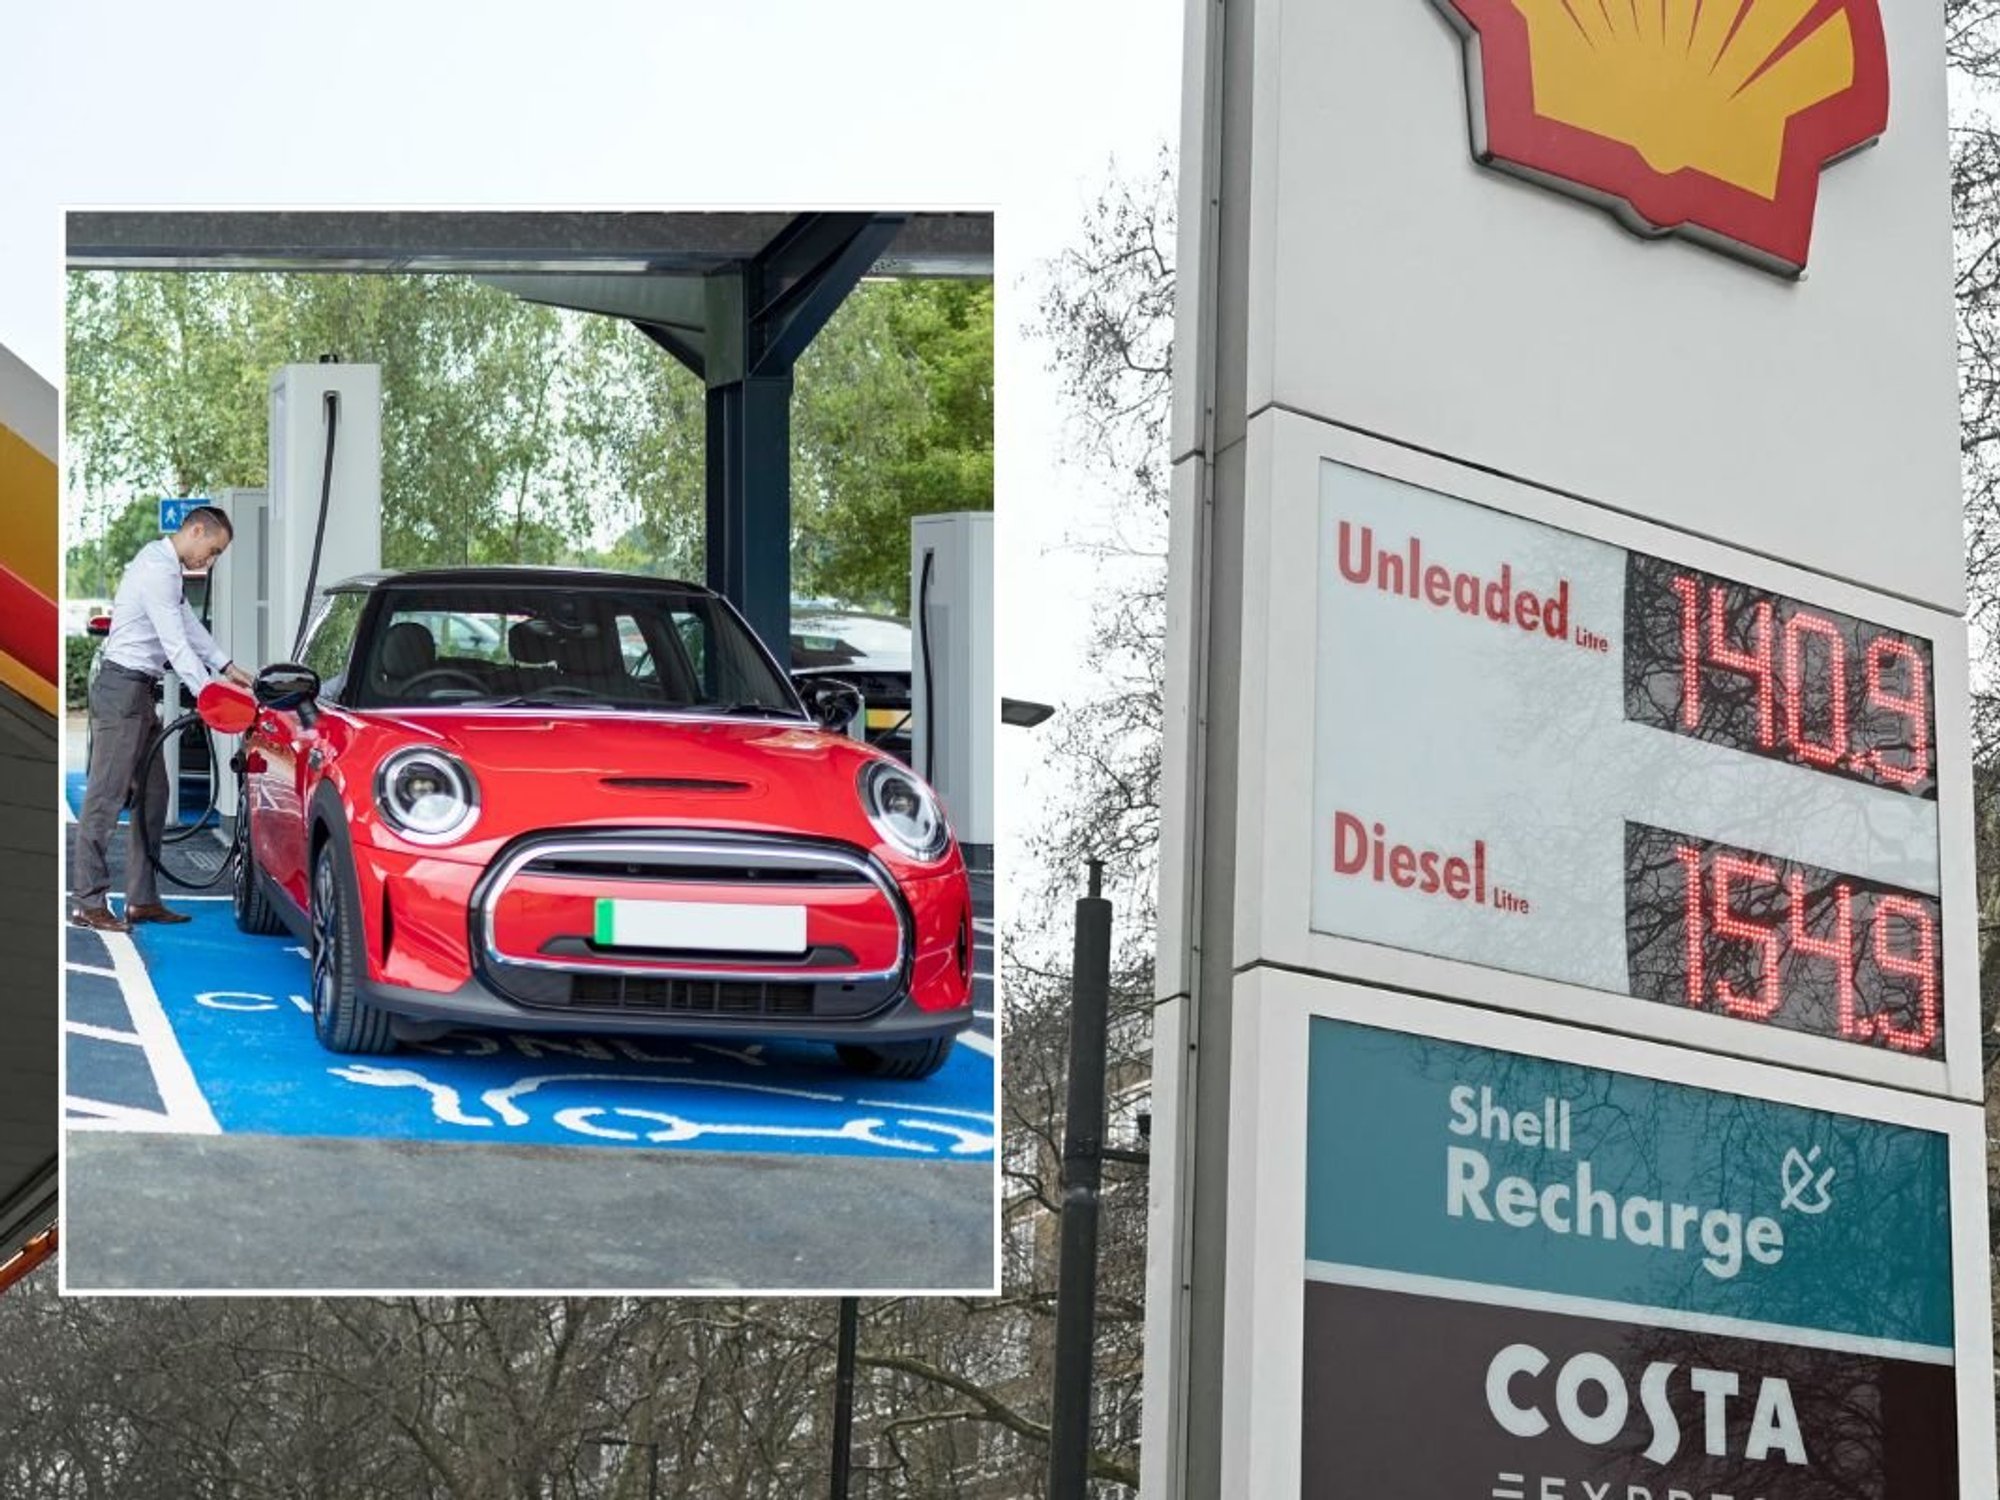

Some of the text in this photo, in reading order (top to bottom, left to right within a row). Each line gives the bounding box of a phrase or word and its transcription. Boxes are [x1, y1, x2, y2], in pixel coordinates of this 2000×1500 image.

[1339, 521, 1609, 653] Unleaded Litre
[1673, 575, 1927, 785] 140.9
[1334, 811, 1530, 914] Diesel Litre
[1676, 845, 1936, 1050] 154.9
[1449, 1086, 1570, 1152] Shell
[1446, 1147, 1784, 1278] Recharge
[1485, 1344, 1809, 1465] COSTA
